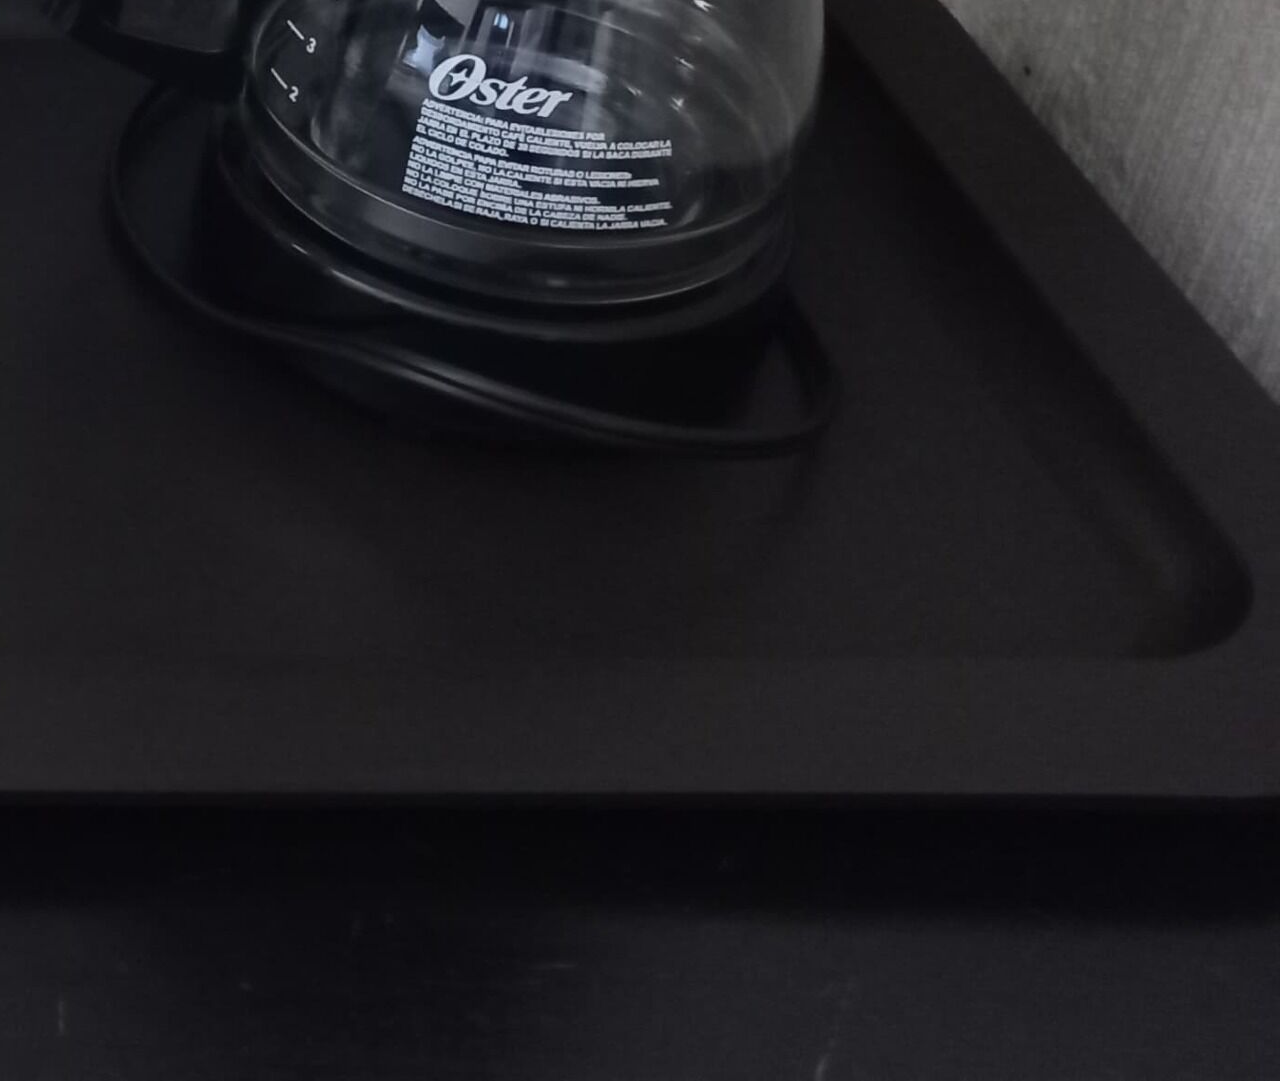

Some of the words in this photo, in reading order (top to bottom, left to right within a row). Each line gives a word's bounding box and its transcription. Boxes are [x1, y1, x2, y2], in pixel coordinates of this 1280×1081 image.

[306, 37, 317, 54] 3
[289, 85, 299, 103] 2
[428, 53, 574, 118] Oster
